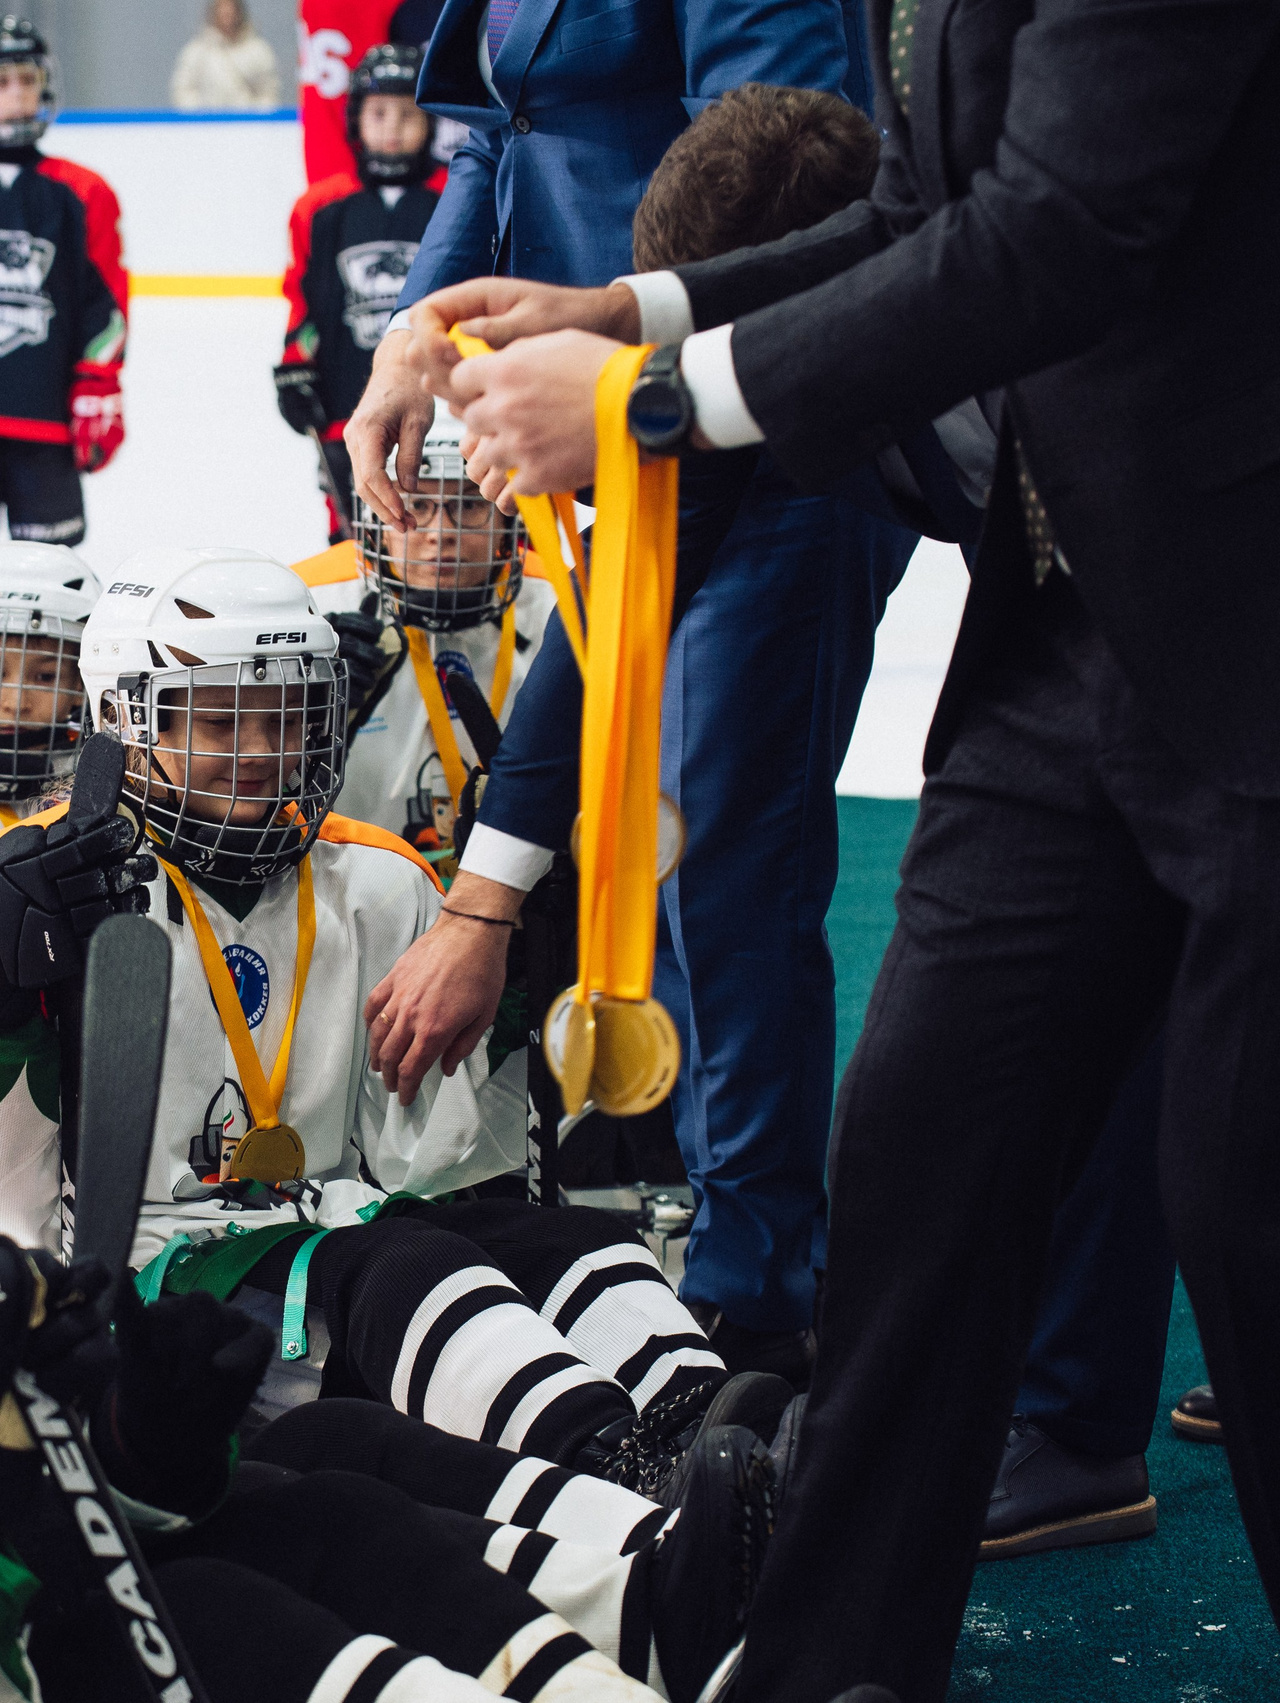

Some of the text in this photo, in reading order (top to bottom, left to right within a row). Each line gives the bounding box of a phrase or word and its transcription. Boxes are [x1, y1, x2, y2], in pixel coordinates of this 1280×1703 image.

[425, 440, 459, 448] EFS
[107, 582, 156, 598] EFSI
[256, 632, 307, 645] EFSI
